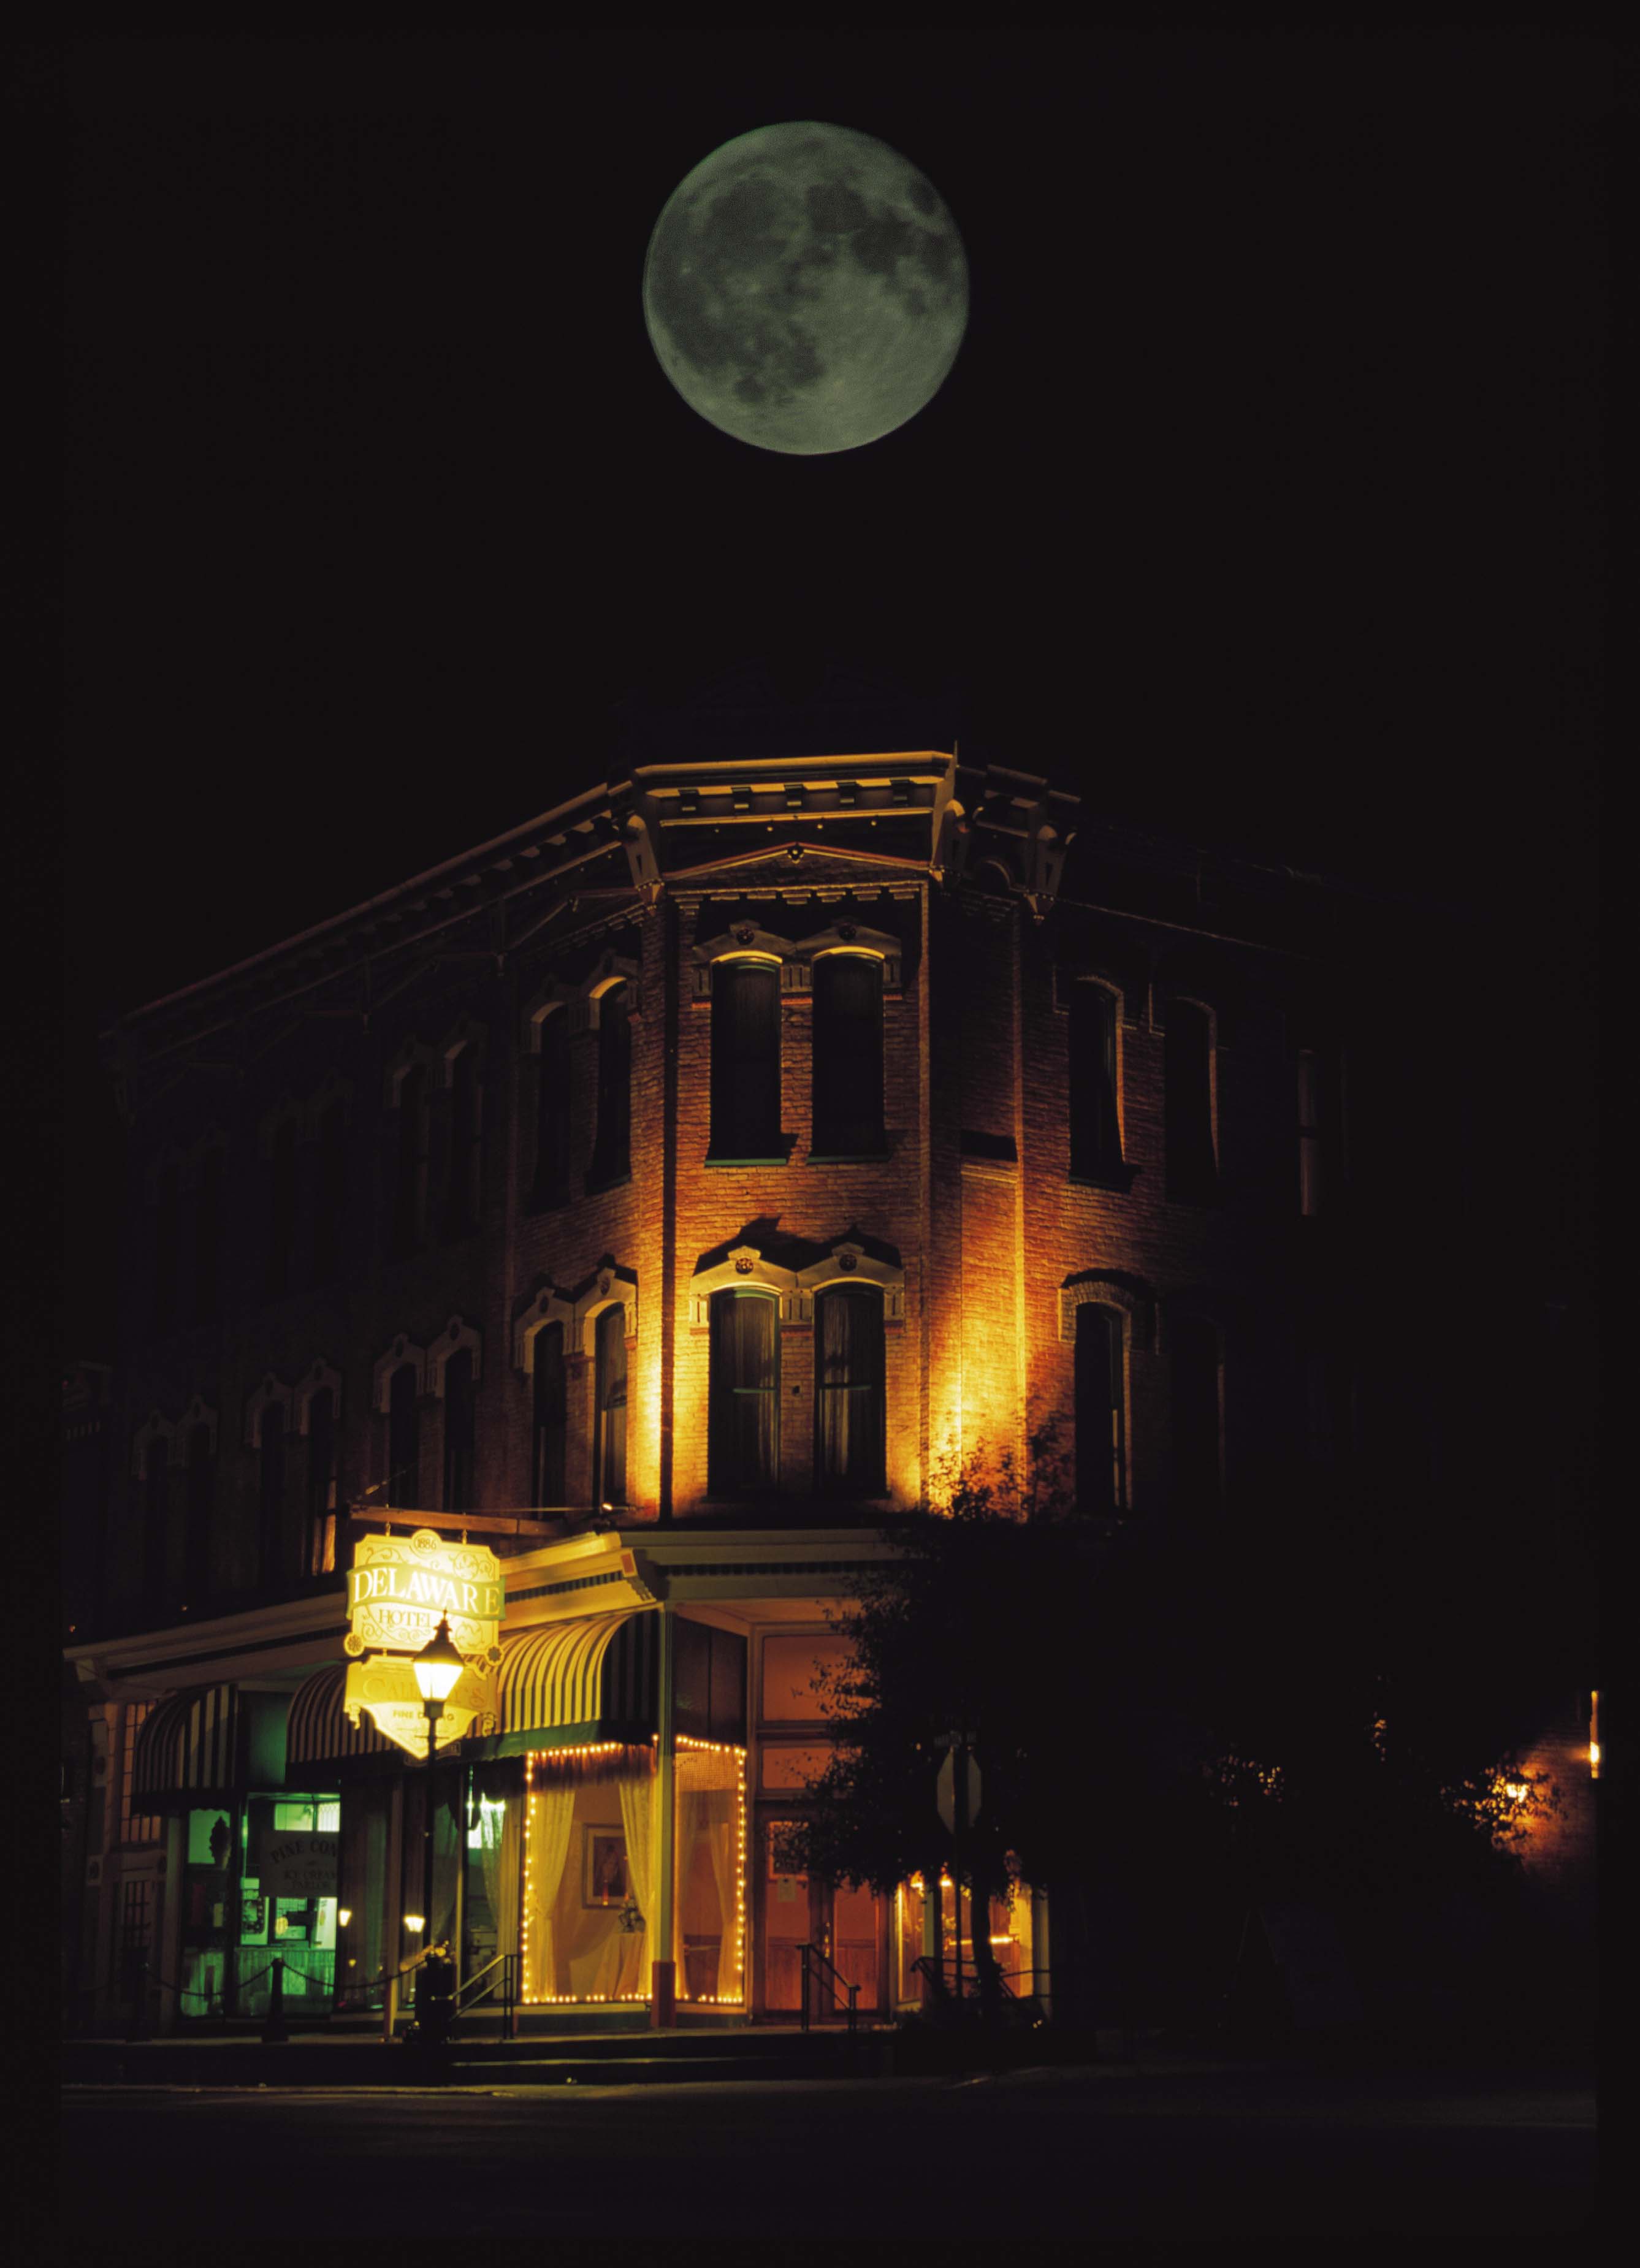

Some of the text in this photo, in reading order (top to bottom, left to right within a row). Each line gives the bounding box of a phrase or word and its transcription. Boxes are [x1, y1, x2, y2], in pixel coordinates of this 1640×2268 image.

[353, 1567, 501, 1616] DELAWARE
[270, 1838, 337, 1864] PINE CON
